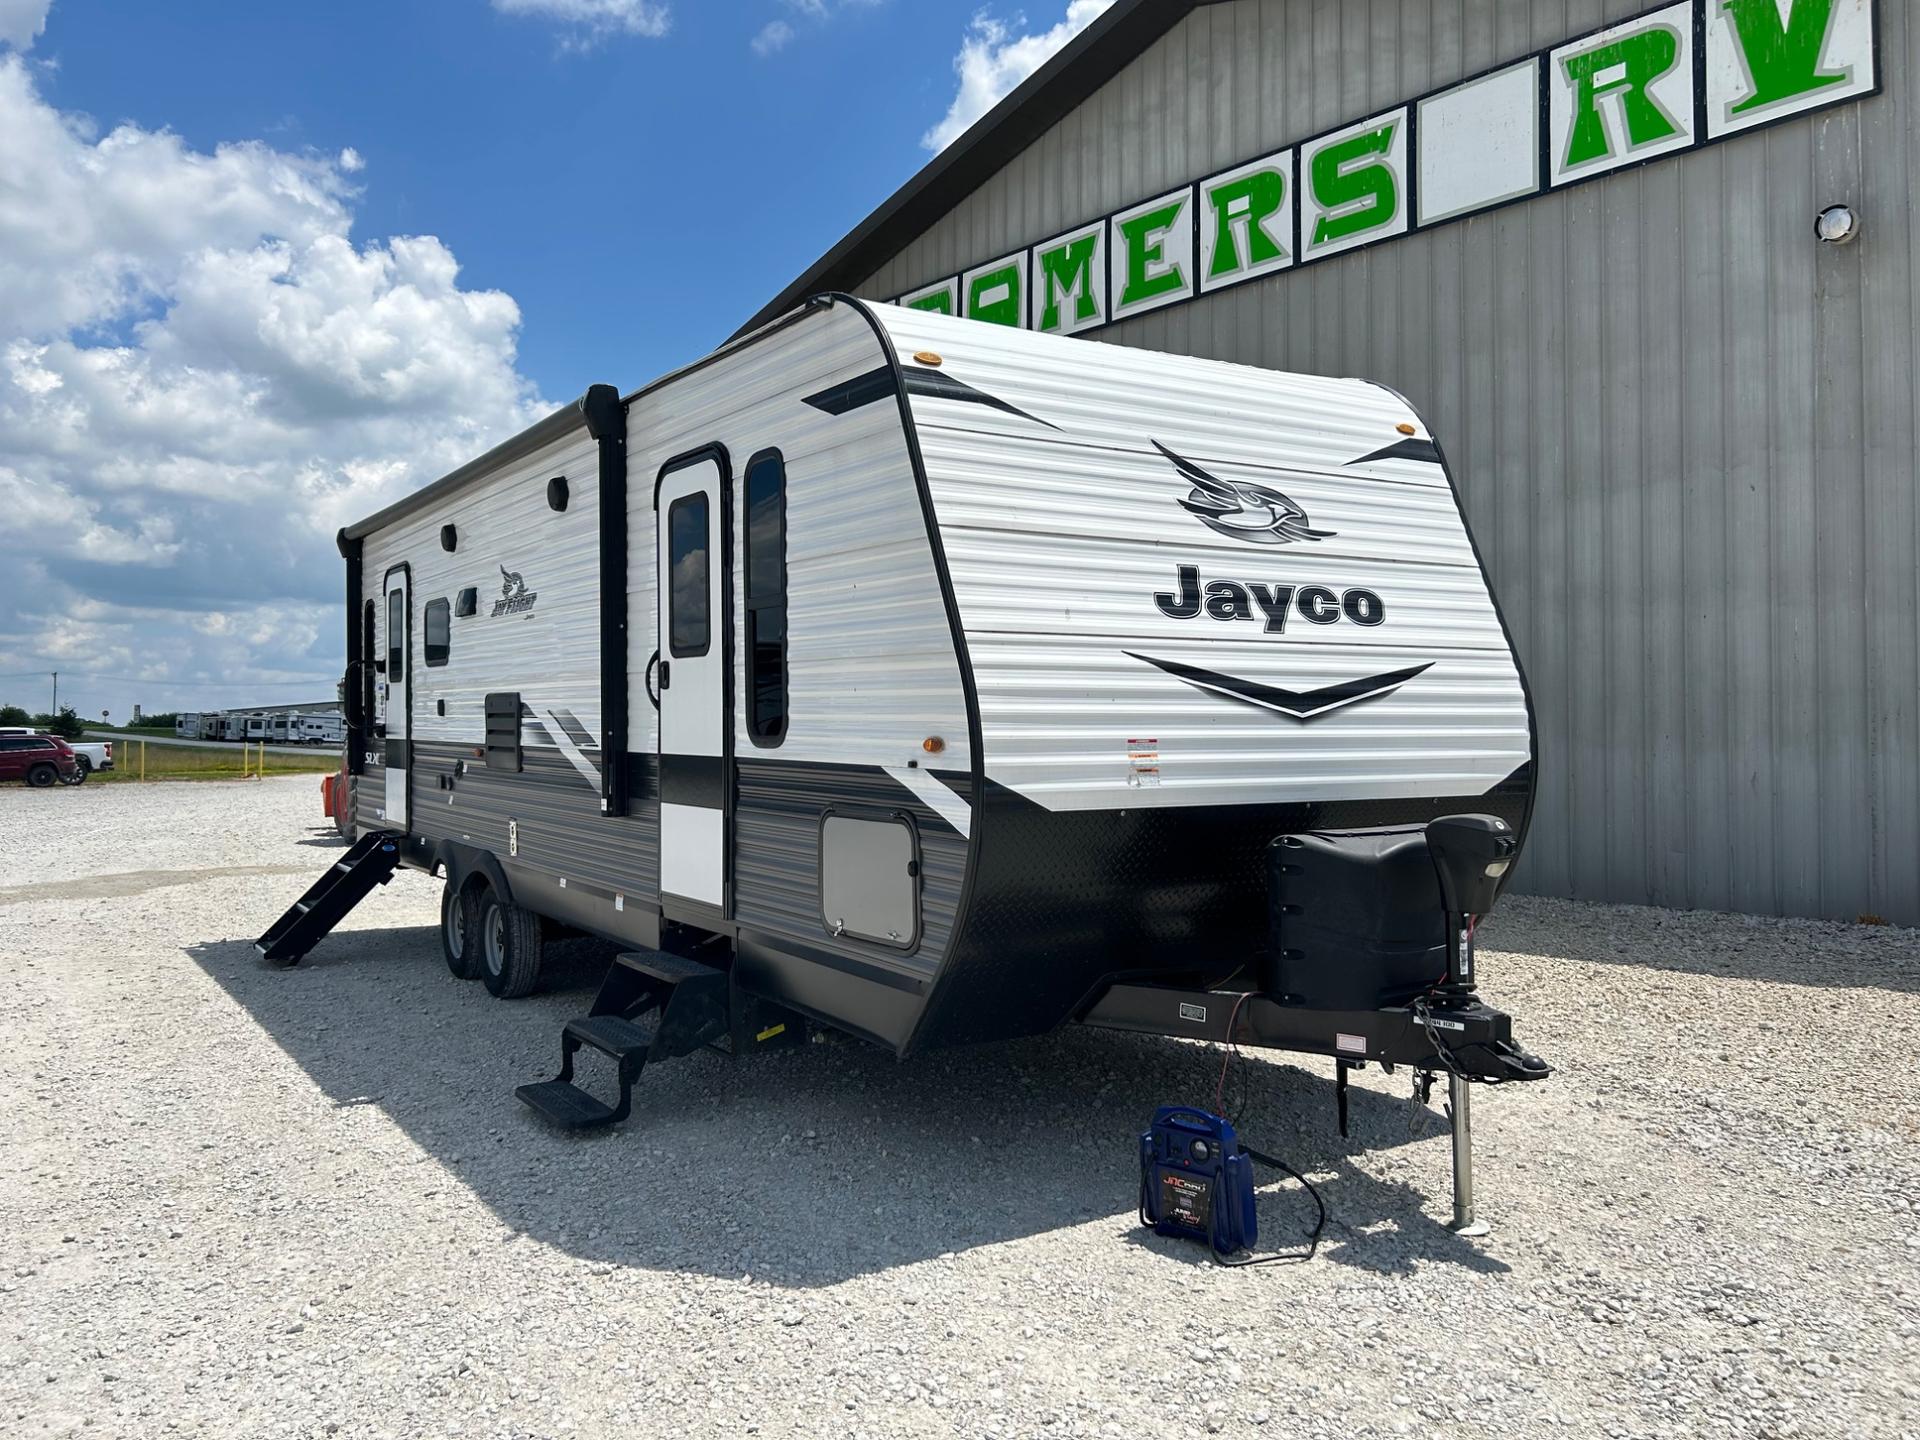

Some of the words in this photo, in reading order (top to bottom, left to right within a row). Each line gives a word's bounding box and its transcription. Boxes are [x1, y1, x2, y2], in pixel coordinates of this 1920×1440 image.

[1558, 0, 1853, 174] RV
[1153, 563, 1386, 635] Jayco
[364, 751, 380, 766] SLX
